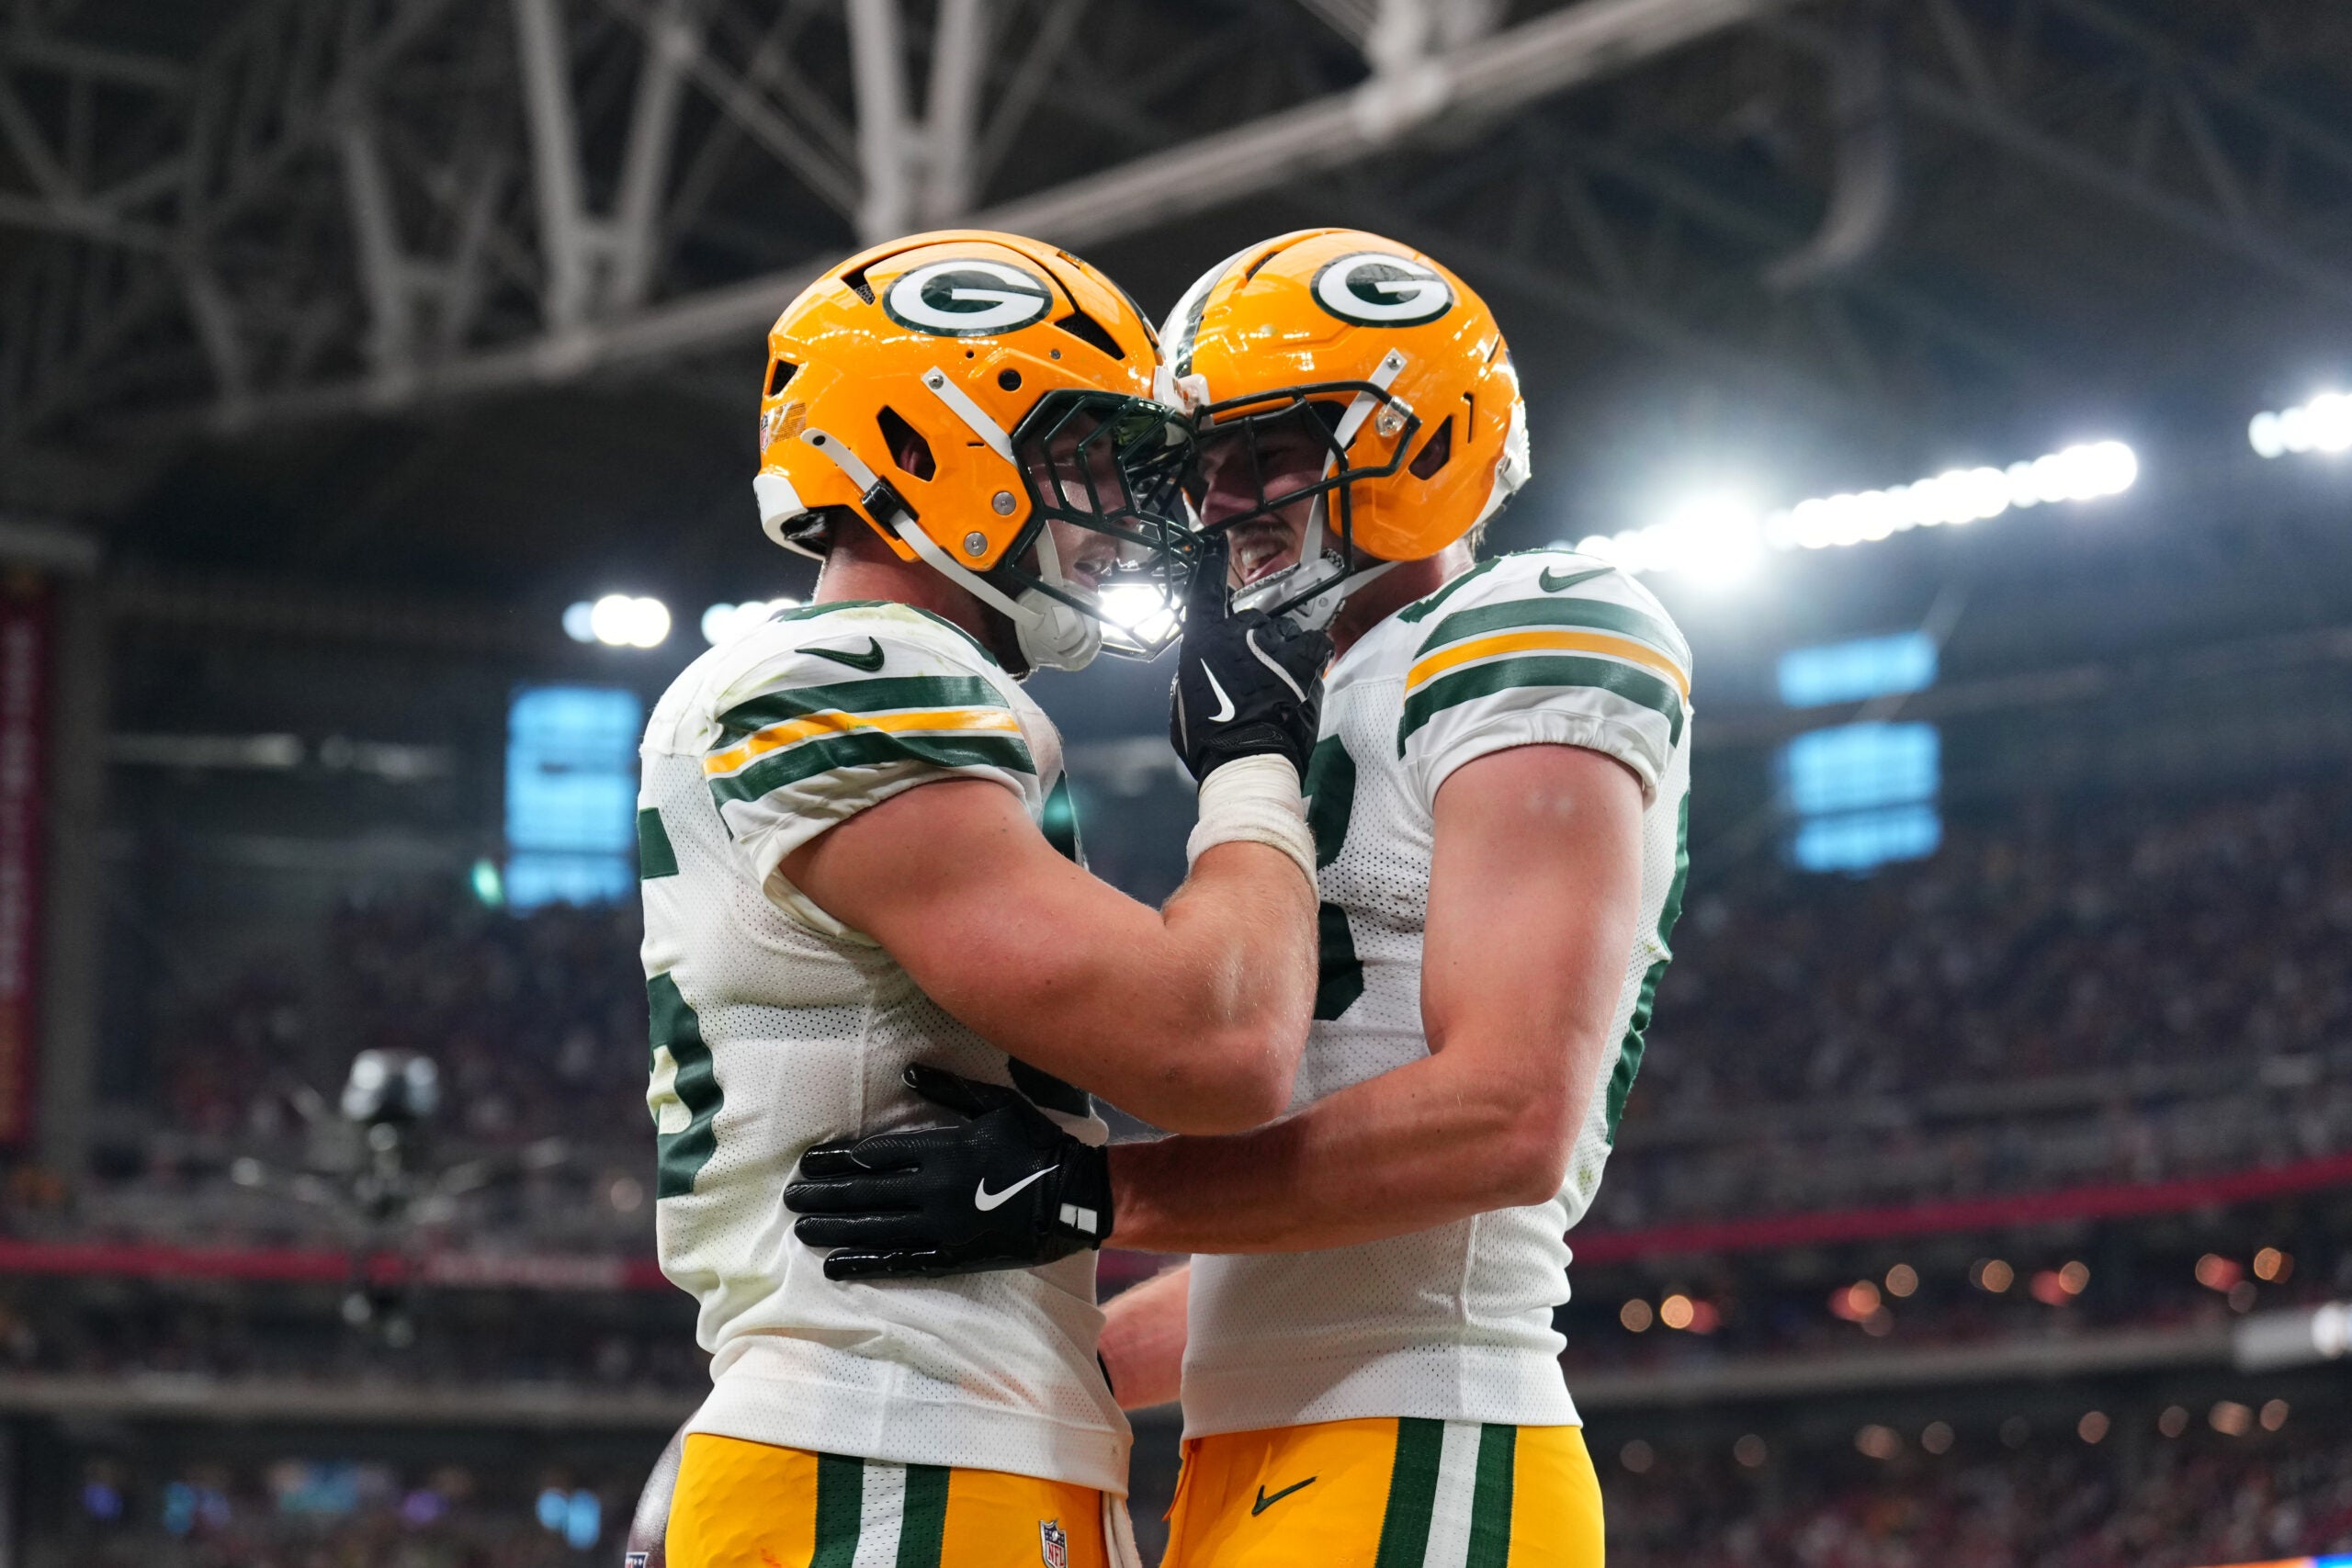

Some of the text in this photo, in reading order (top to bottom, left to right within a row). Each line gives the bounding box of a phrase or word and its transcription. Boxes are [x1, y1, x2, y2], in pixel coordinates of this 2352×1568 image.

[889, 261, 1045, 329] G
[1317, 254, 1449, 321] G
[1047, 1541, 1065, 1567] NFL
